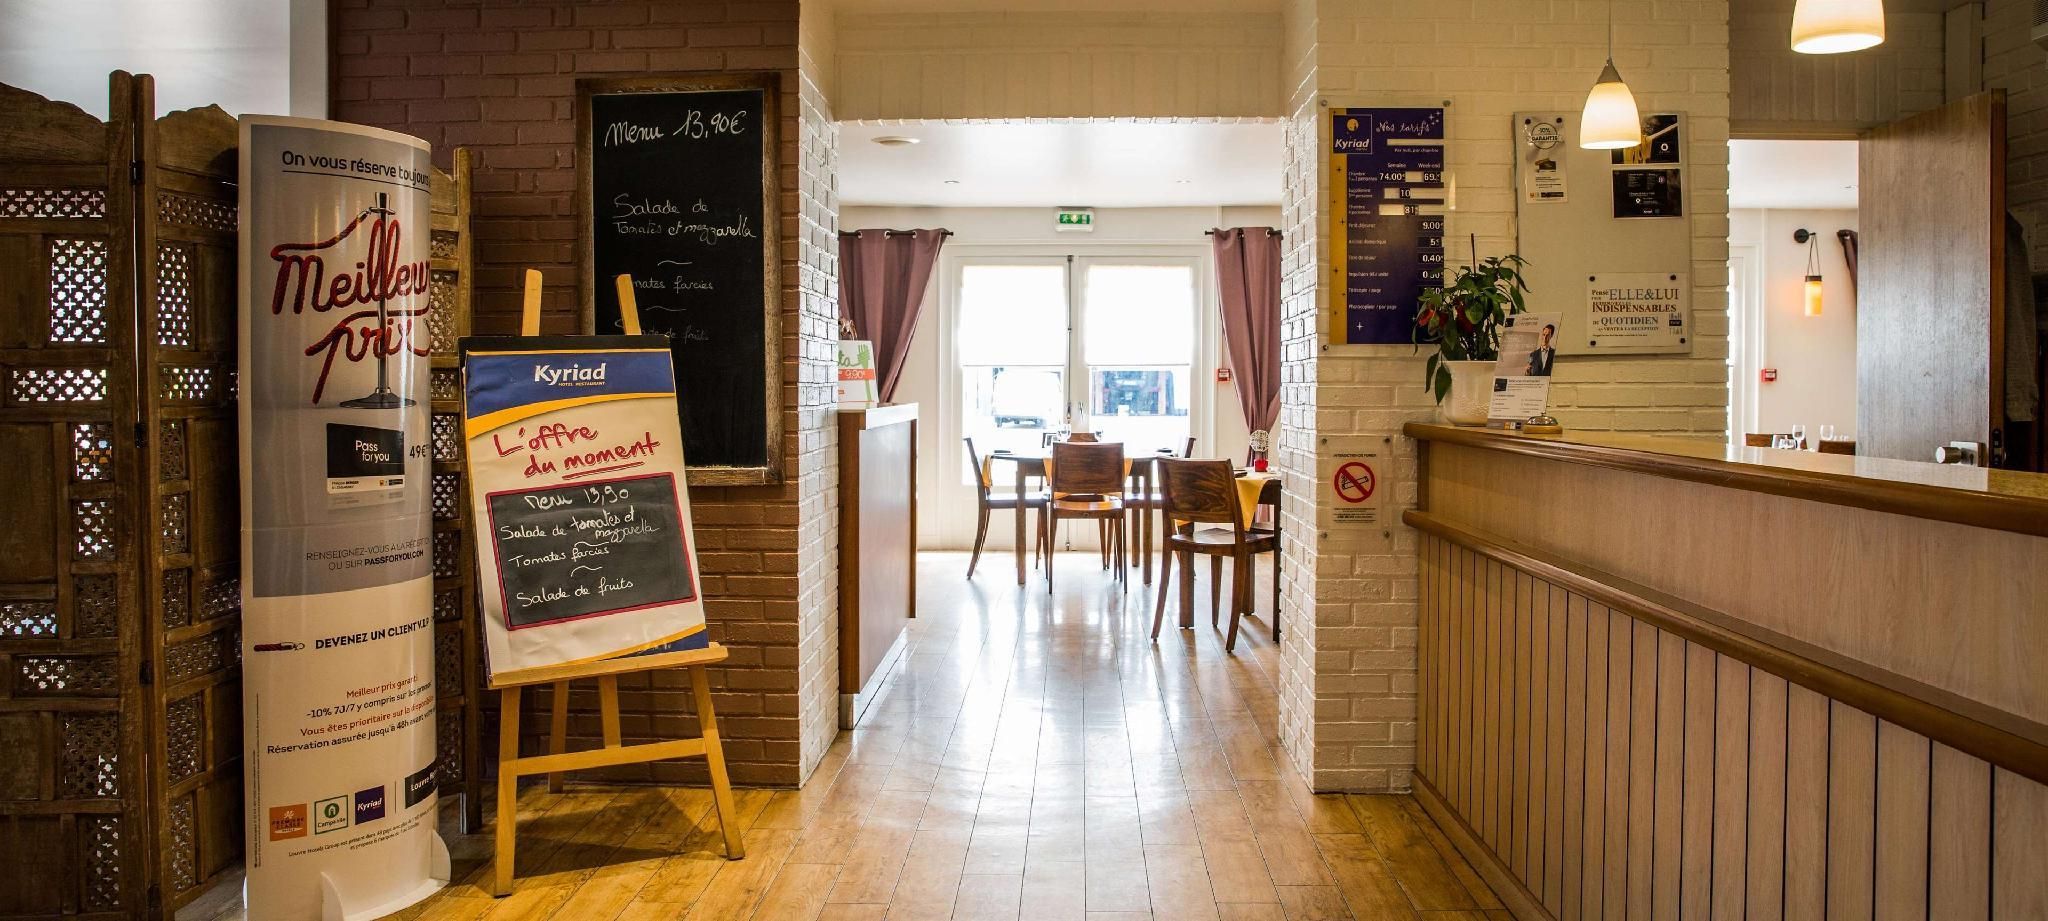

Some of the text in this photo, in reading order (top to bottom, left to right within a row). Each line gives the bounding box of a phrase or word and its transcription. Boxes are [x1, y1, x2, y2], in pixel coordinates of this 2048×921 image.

[604, 110, 747, 147] Menu 13,90€
[1376, 120, 1395, 133] Nos
[1334, 138, 1370, 150] Kyriad
[282, 150, 305, 166] On
[308, 155, 347, 170] vous
[350, 157, 397, 178] réserve
[1400, 189, 1411, 197] 10
[612, 193, 709, 218] Salade de
[270, 218, 431, 315] Meilleur
[673, 275, 714, 295] farcies
[1609, 288, 1680, 300] ELLE&LUI
[1592, 304, 1677, 313] INDISPENSABLES
[1600, 316, 1659, 326] QUOTIDIEN
[534, 362, 607, 386] Kyriad
[355, 440, 378, 452] Pass
[493, 423, 598, 457] L'offre
[409, 445, 426, 459] 49€
[523, 431, 660, 478] du moment
[524, 485, 629, 511] Menu 13,90
[500, 505, 635, 541] Salade de tomates et
[306, 544, 390, 561] RENSEIGNEZ-VOUS
[508, 546, 610, 568] Tomates farcies
[328, 561, 343, 571] OU
[345, 559, 363, 569] SUR
[516, 576, 634, 608] Salade de fruits
[315, 632, 369, 650] DEVENEZ
[370, 628, 386, 641] UN
[388, 622, 417, 637] CLIENT
[346, 685, 380, 699] Meilleur
[381, 681, 397, 693] prix
[306, 708, 332, 719] -10%
[356, 704, 363, 713] y
[363, 695, 396, 709] compris
[396, 693, 407, 701] sur
[300, 726, 325, 737] Vous
[327, 723, 348, 733] êtes
[349, 713, 391, 730] prioritaire
[392, 710, 404, 718] sur
[404, 706, 410, 714] la
[267, 739, 330, 755] Réservation
[331, 732, 367, 746] assurée
[357, 798, 383, 812] Kyriad
[288, 849, 306, 857] Louvre
